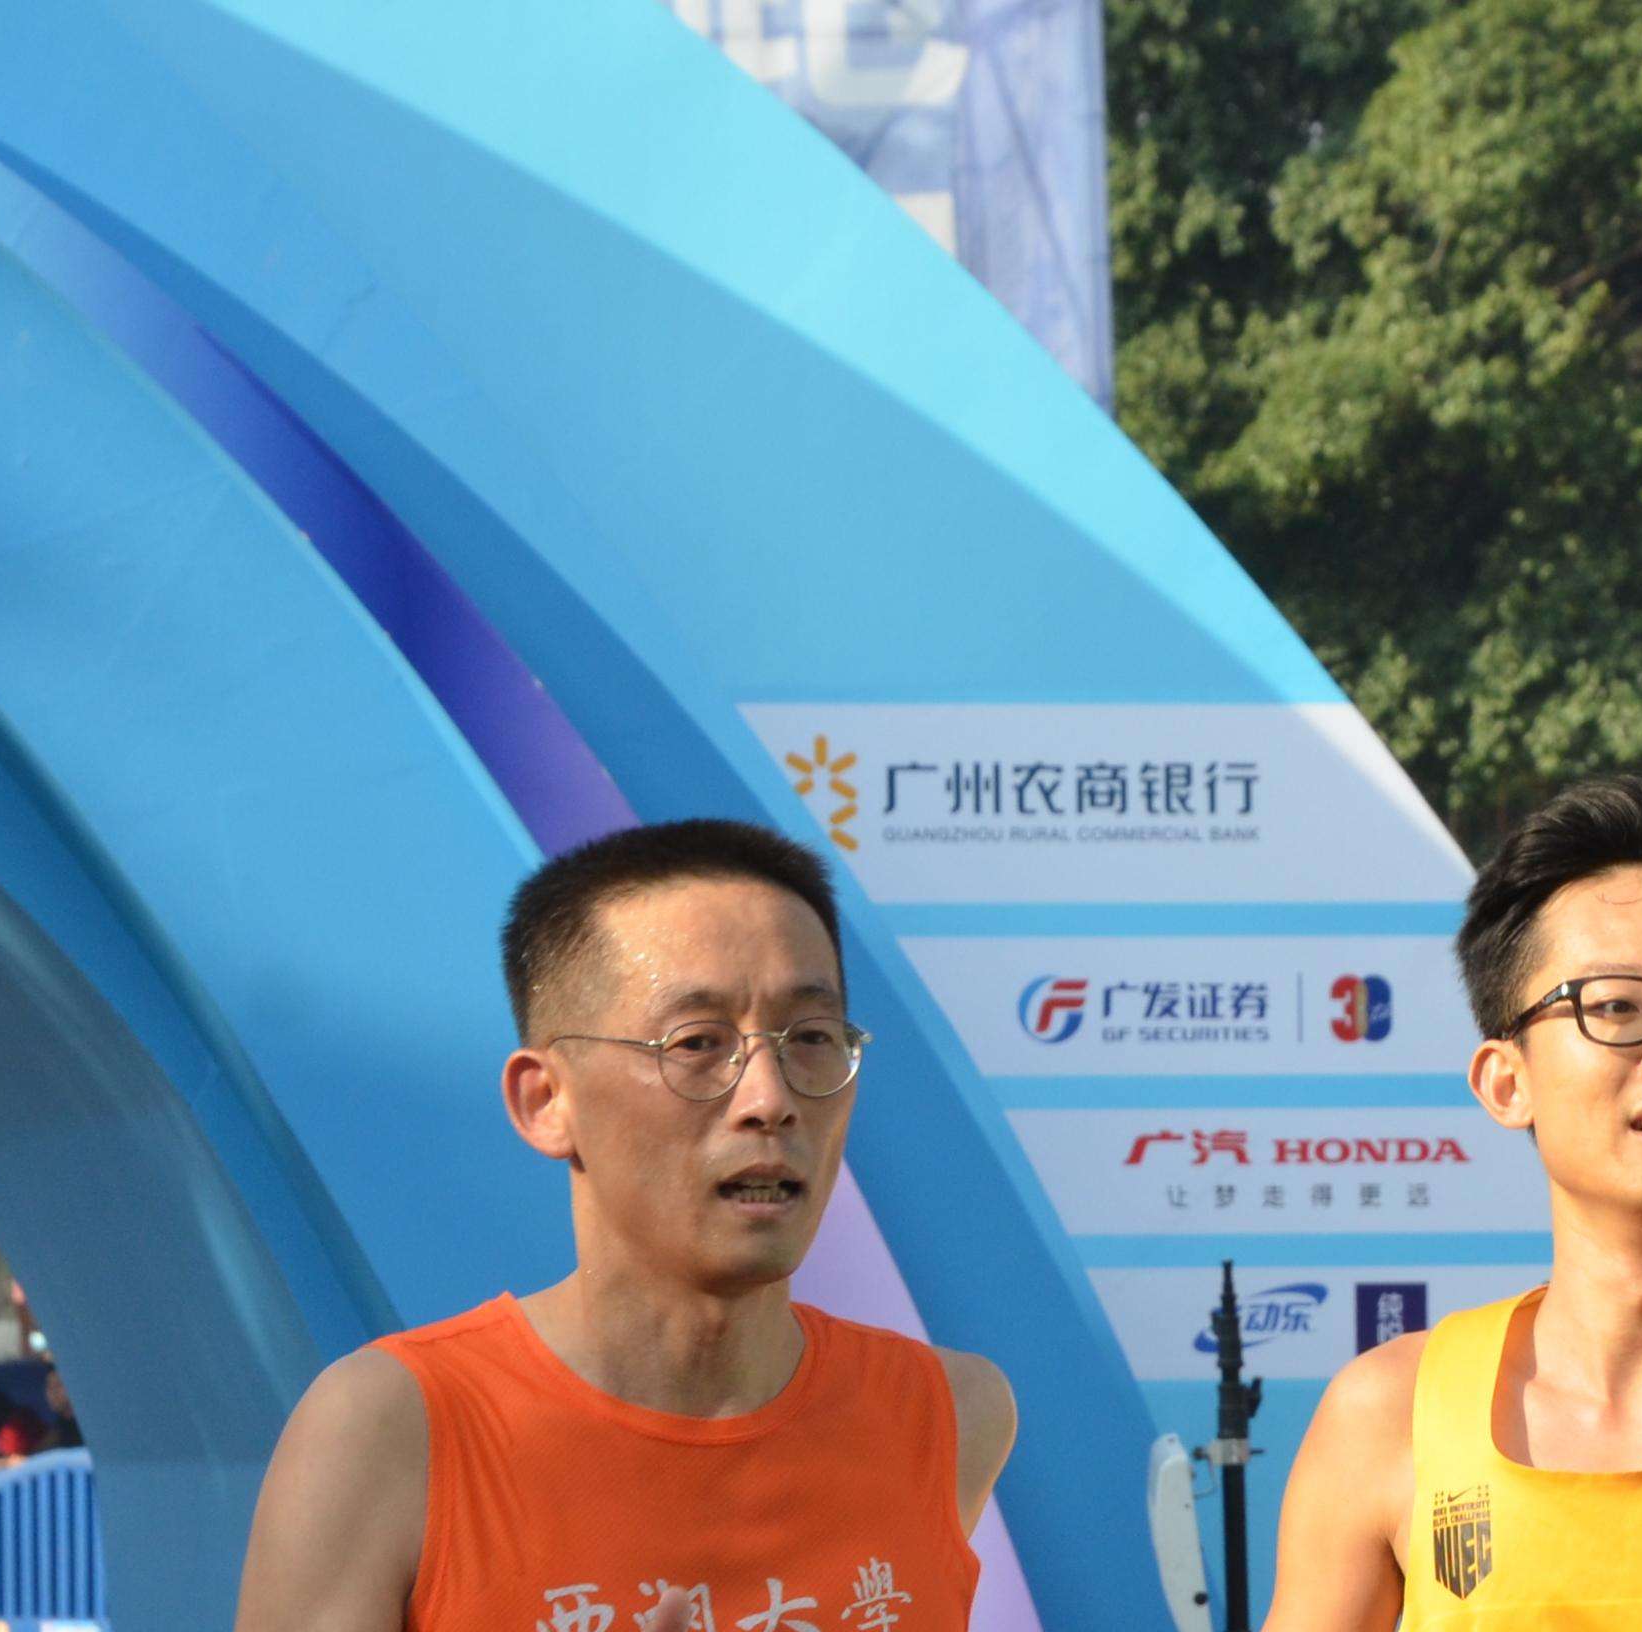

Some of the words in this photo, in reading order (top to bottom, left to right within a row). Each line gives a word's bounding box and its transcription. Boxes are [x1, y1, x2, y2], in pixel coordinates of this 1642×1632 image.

[883, 762, 1260, 815] 广州农商银行
[882, 826, 1004, 843] GUANGZHOU
[1008, 826, 1071, 842] RURAL
[1076, 826, 1202, 842] COMMERCIAL
[1209, 826, 1260, 842] BANK
[1102, 980, 1269, 1021] 广发证券
[1102, 1026, 1132, 1042] GF
[1138, 1026, 1269, 1042] SECURITIES
[1124, 1130, 1251, 1165] 广汽
[1273, 1138, 1470, 1165] HONDA
